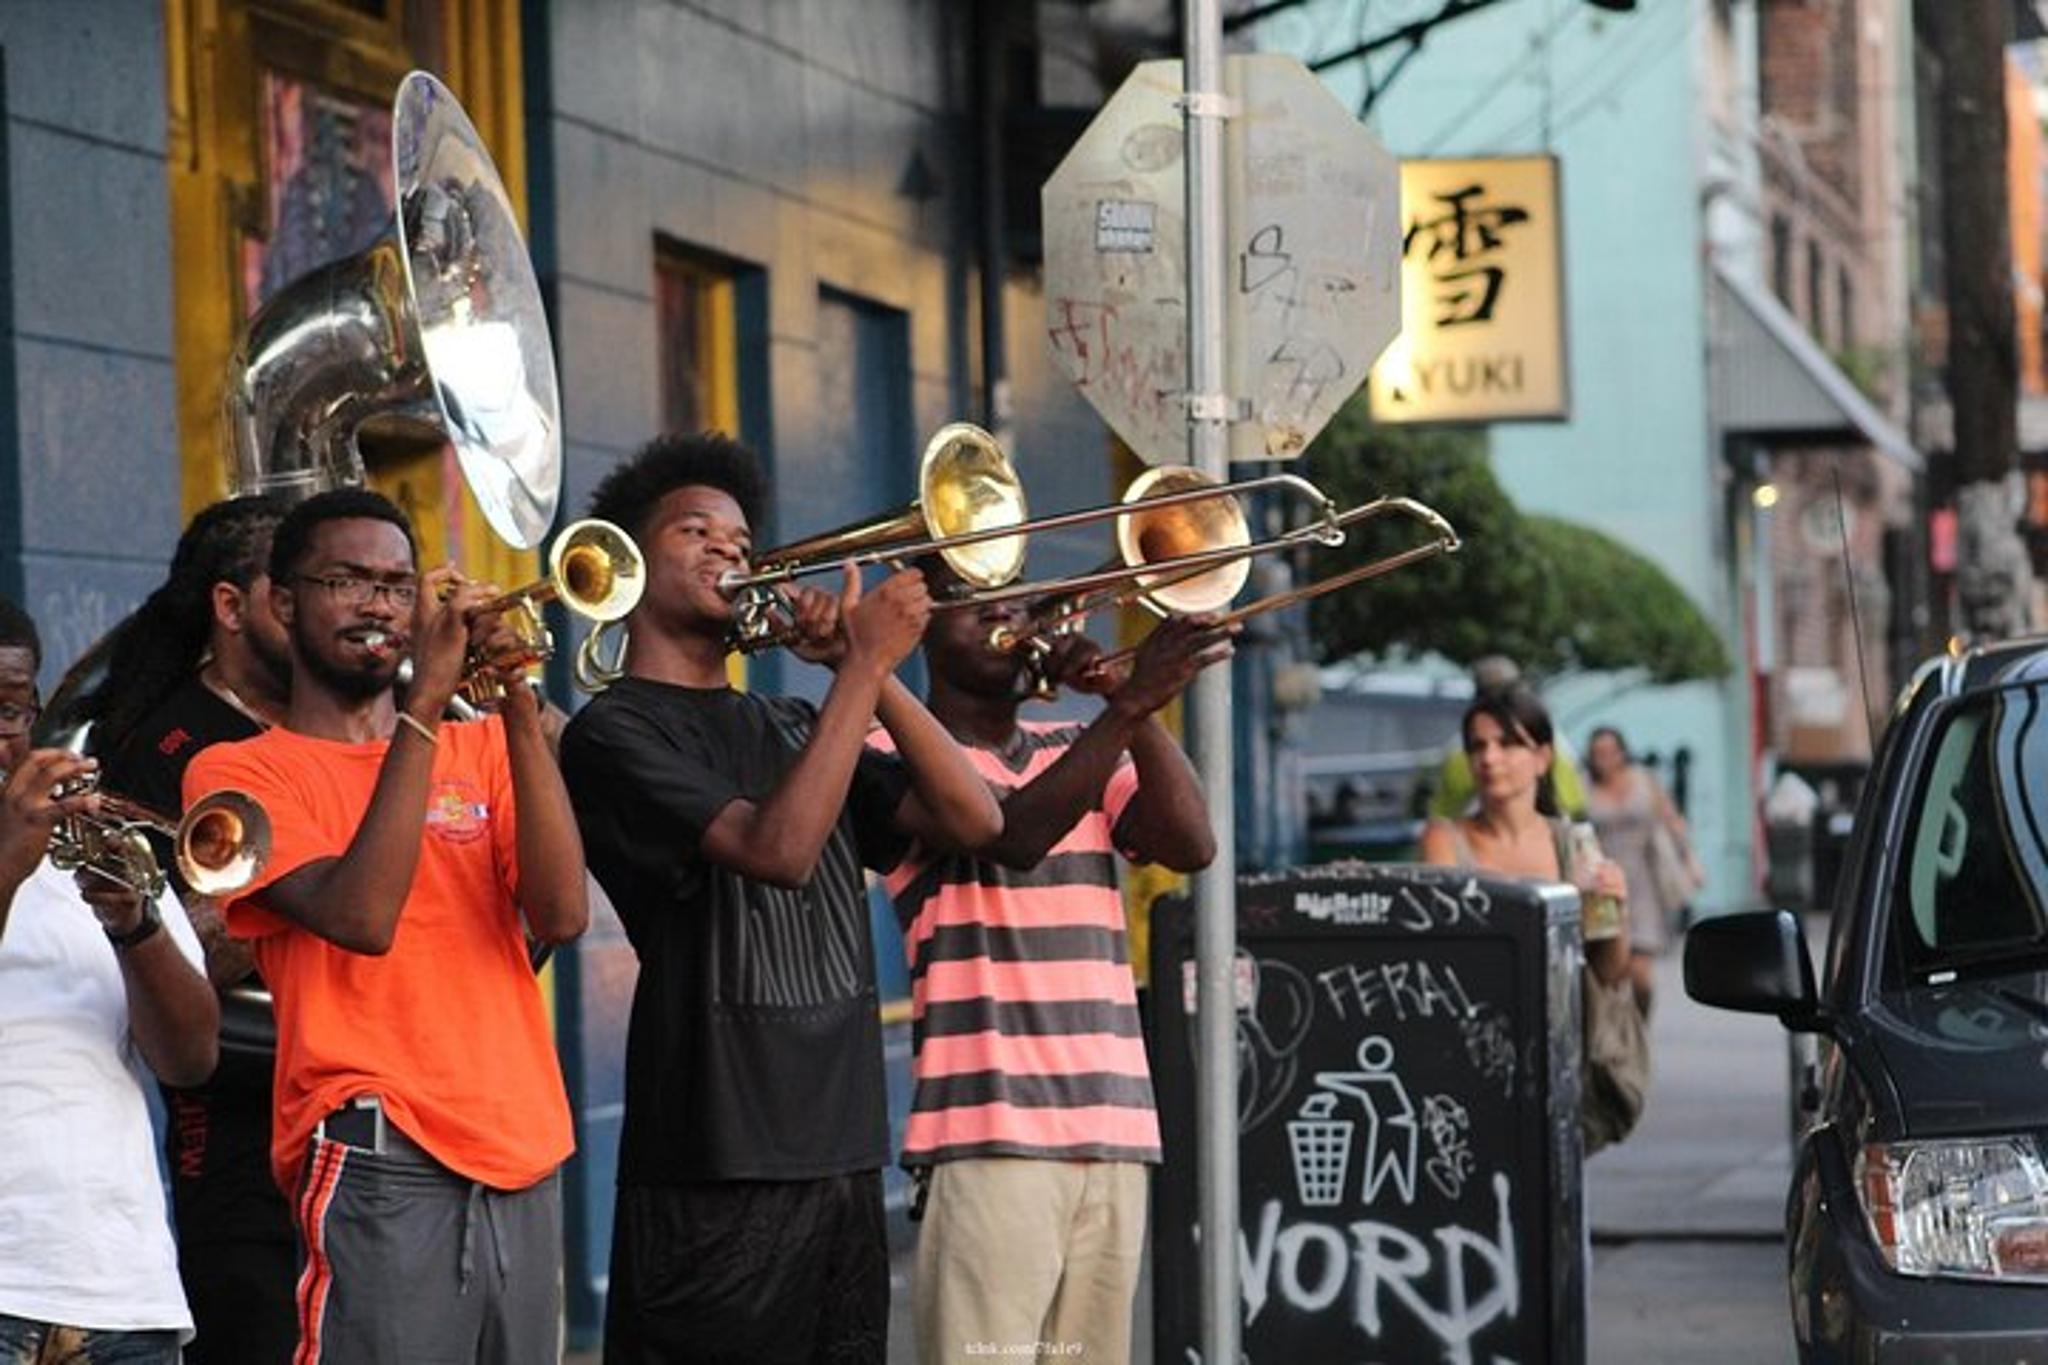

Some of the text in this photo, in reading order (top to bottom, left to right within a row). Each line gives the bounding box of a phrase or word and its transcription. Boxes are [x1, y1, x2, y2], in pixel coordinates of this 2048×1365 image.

[1403, 184, 1529, 327] 雪
[1414, 356, 1524, 395] YUKI
[1317, 960, 1488, 1021] FERAL
